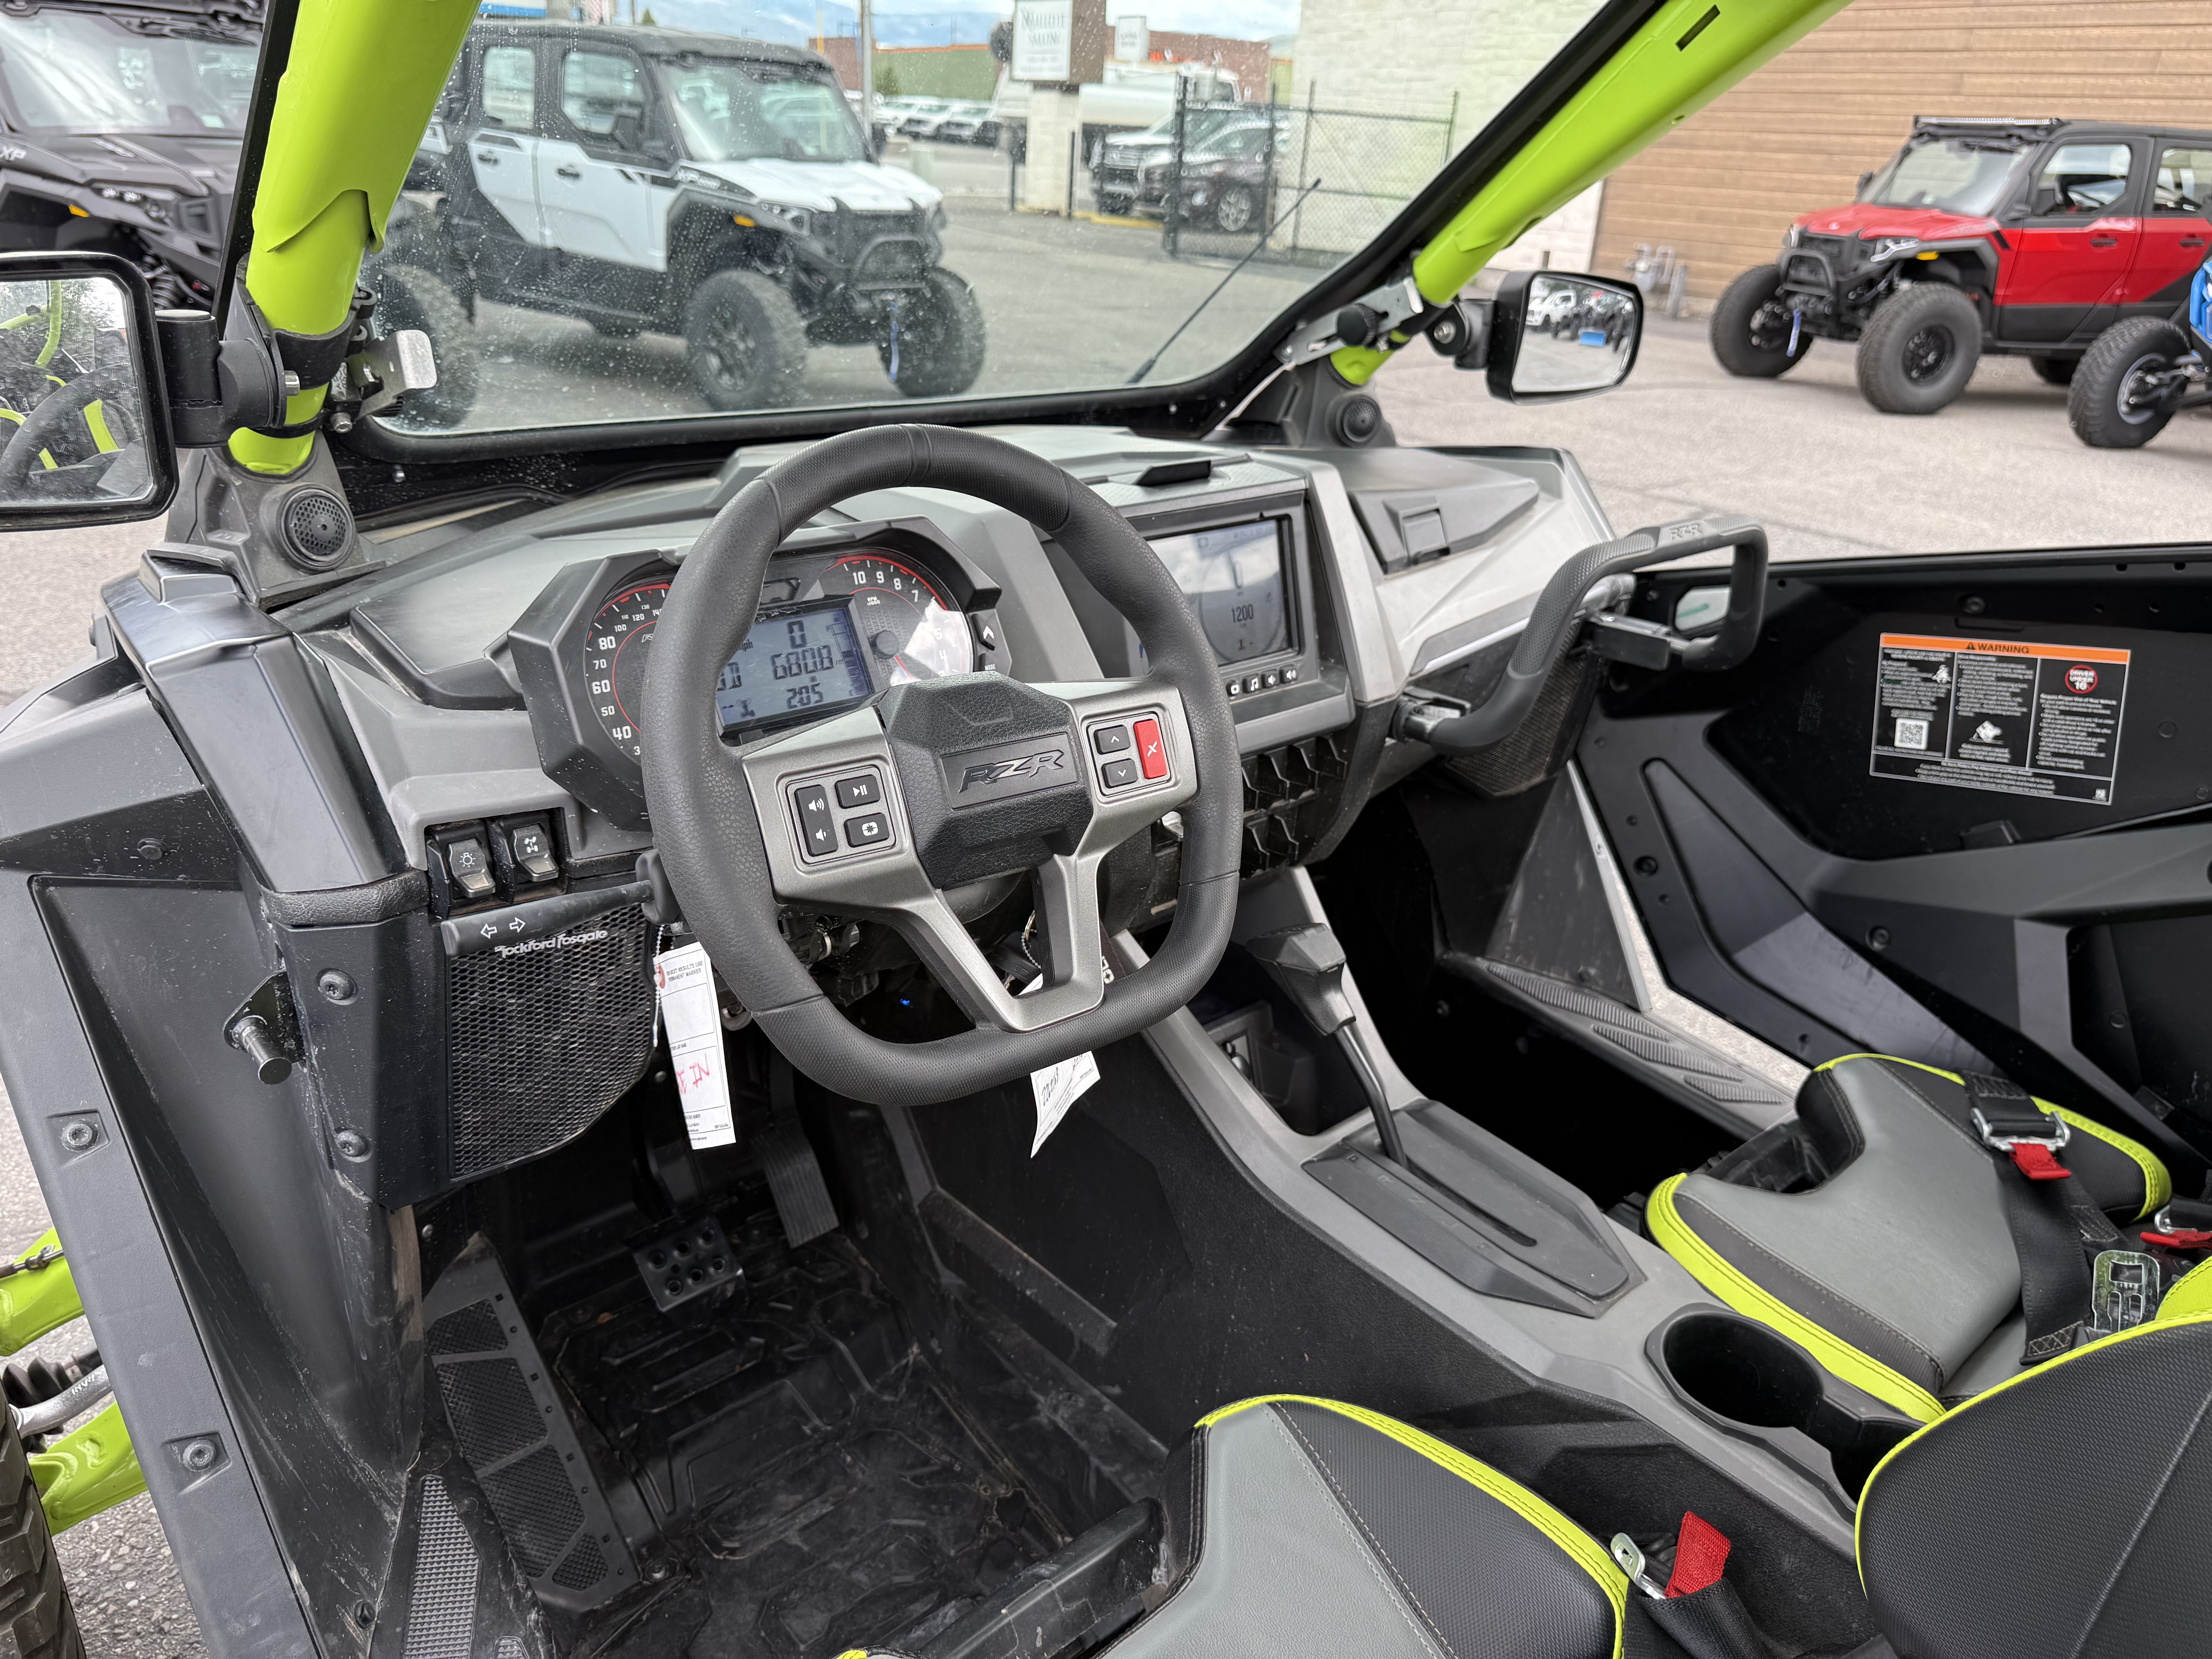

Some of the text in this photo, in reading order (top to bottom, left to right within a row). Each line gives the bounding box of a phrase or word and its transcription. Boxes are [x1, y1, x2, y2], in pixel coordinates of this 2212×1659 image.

[853, 571, 866, 585] 10
[876, 571, 884, 584] 9
[893, 578, 902, 590] 8
[912, 589, 918, 602] 7
[632, 613, 645, 622] 120
[1231, 604, 1254, 623] 1200
[614, 624, 627, 632] 100
[787, 620, 807, 649] 0
[935, 628, 942, 640] 5
[598, 636, 616, 650] 80
[1978, 643, 2029, 654] WARNING
[939, 649, 948, 662] 4
[593, 659, 607, 670] 70
[592, 680, 611, 694] 60
[601, 706, 615, 716] 50
[612, 725, 632, 740] 40
[958, 749, 1064, 793] RZR
